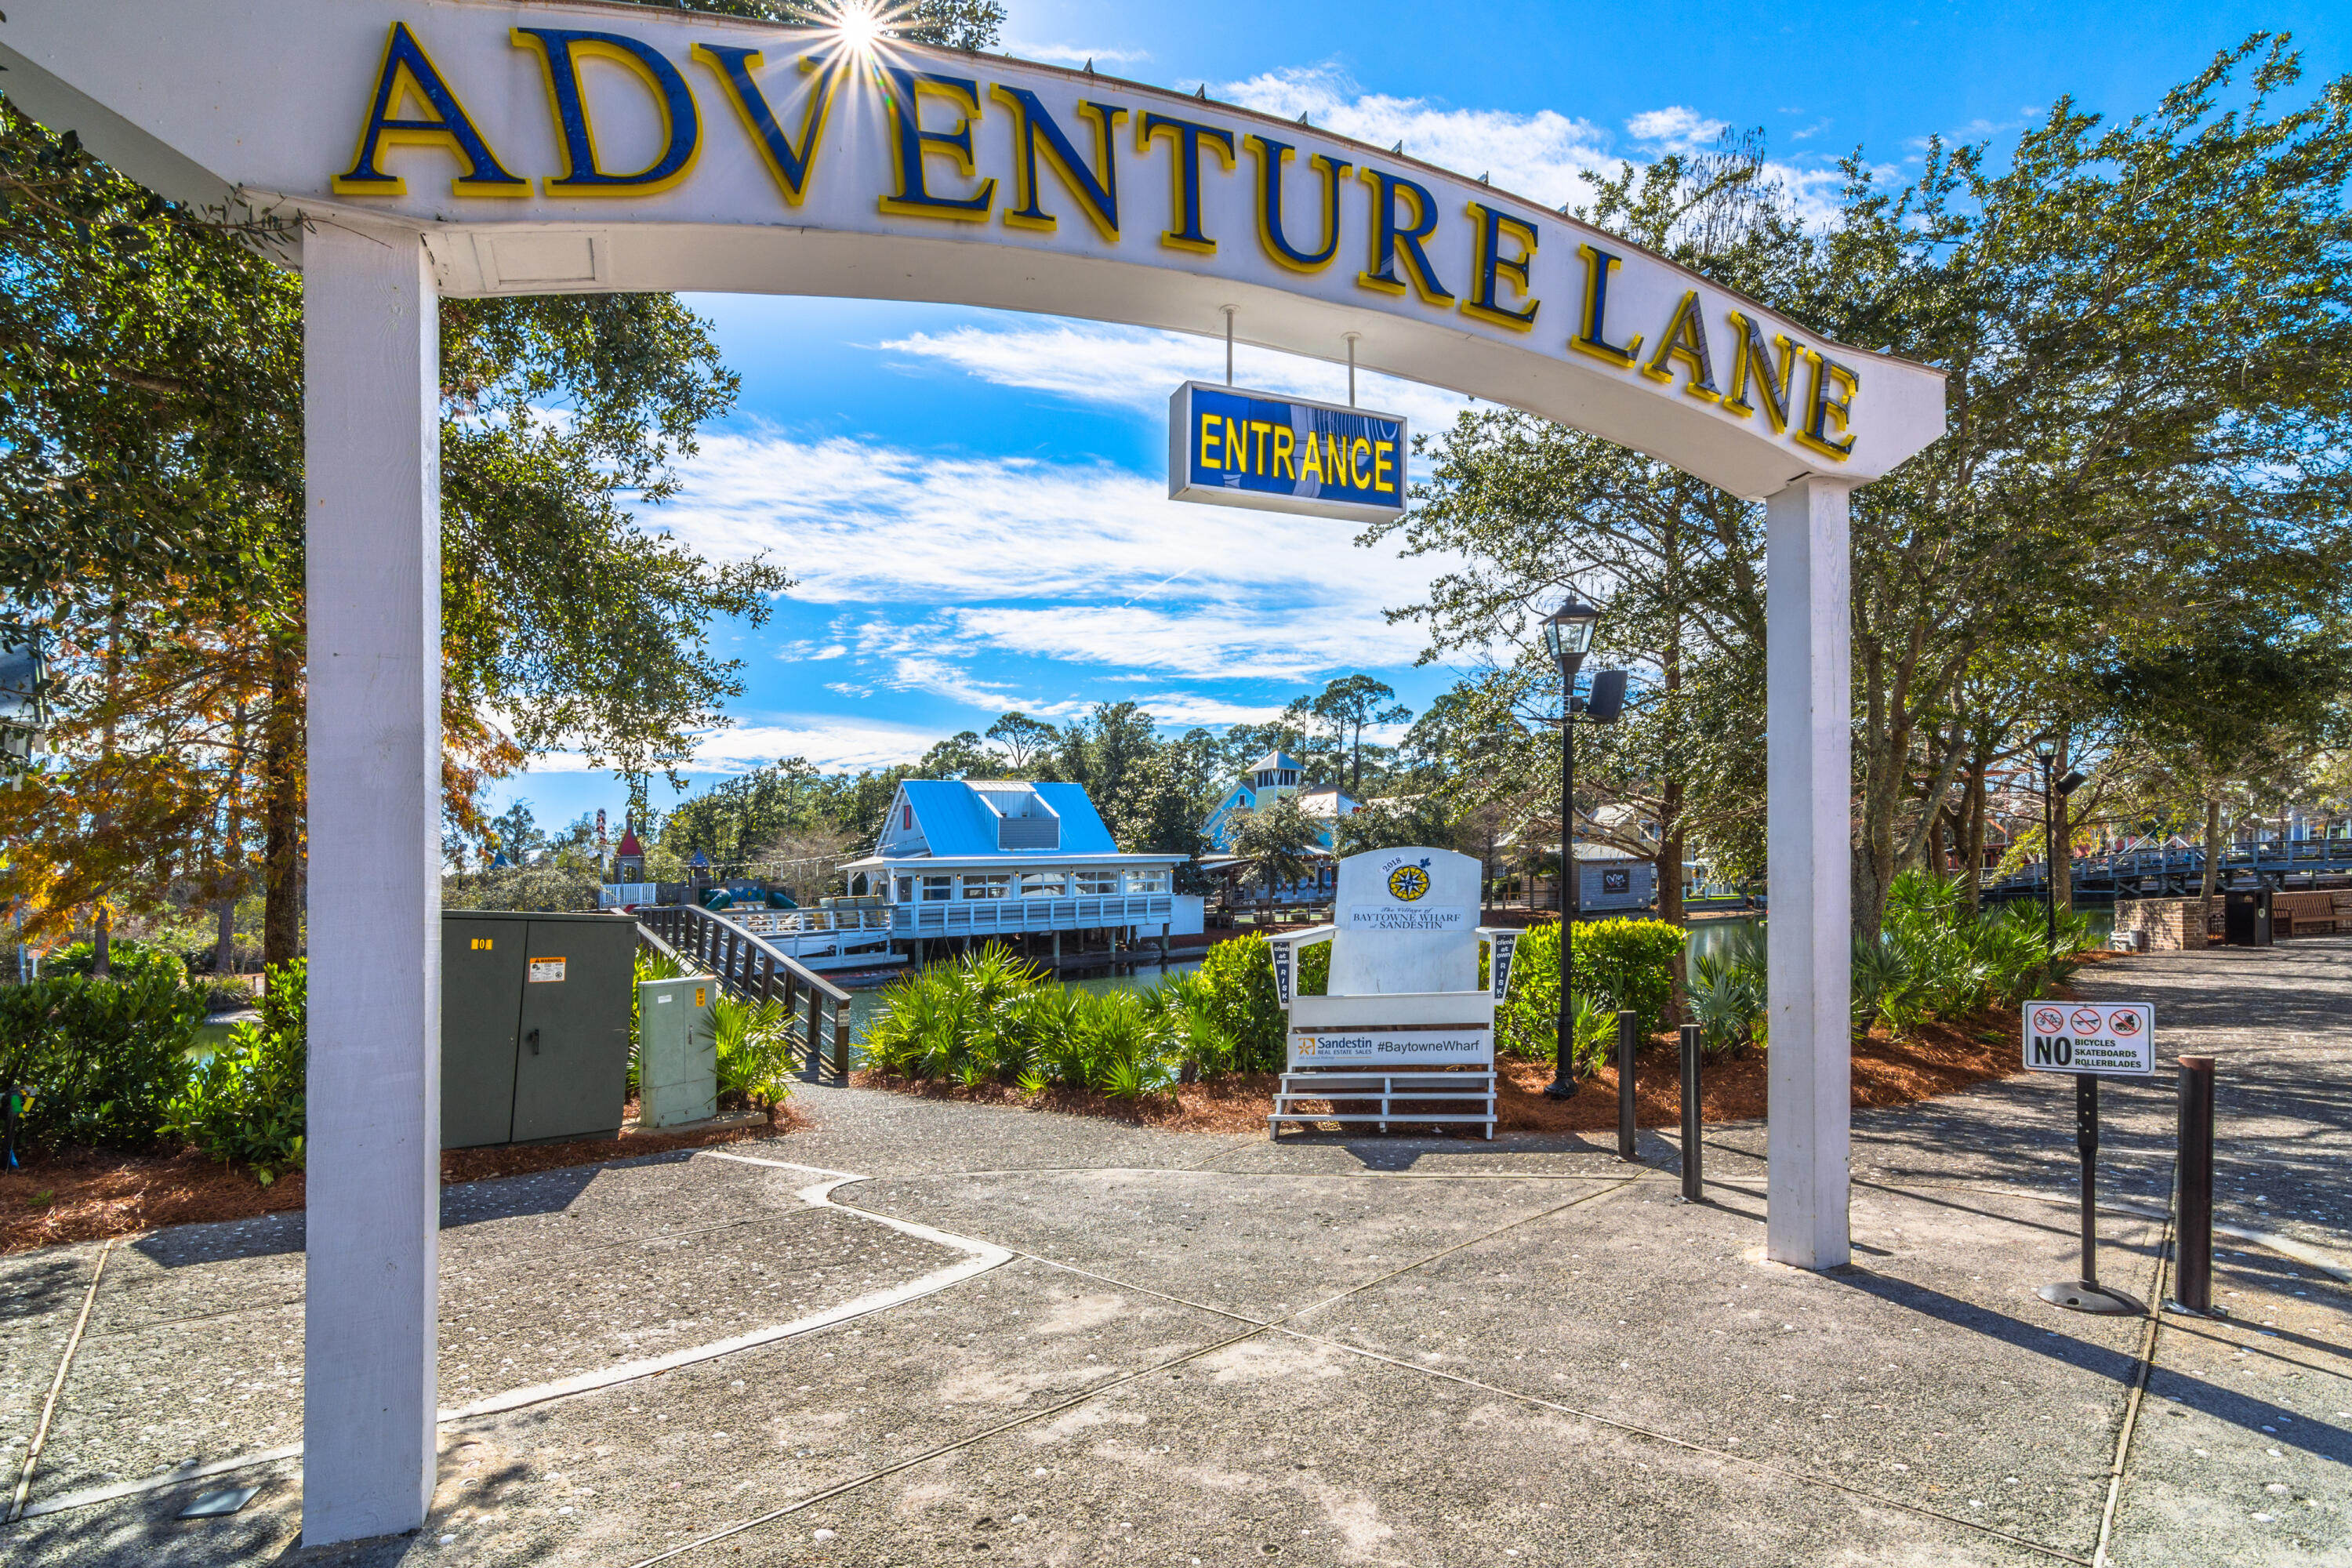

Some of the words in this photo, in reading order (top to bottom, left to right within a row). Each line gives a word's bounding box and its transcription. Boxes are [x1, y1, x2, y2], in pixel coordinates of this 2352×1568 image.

[331, 21, 1541, 332] ADVENTURE
[1572, 243, 1860, 462] LANE
[1200, 412, 1394, 493] ENTRANCE
[1382, 857, 1402, 872] 2018
[1353, 913, 1415, 922] BAYTOWNE
[1420, 913, 1461, 922] WHARF
[1497, 962, 1506, 994] RISK
[1317, 1037, 1372, 1049] Sandestin
[1377, 1040, 1480, 1054] #BaytowneWharf
[2034, 1036, 2072, 1066] NO
[2074, 1049, 2137, 1058] SKATEBOARDS
[2074, 1058, 2142, 1069] ROLLERBLADES
